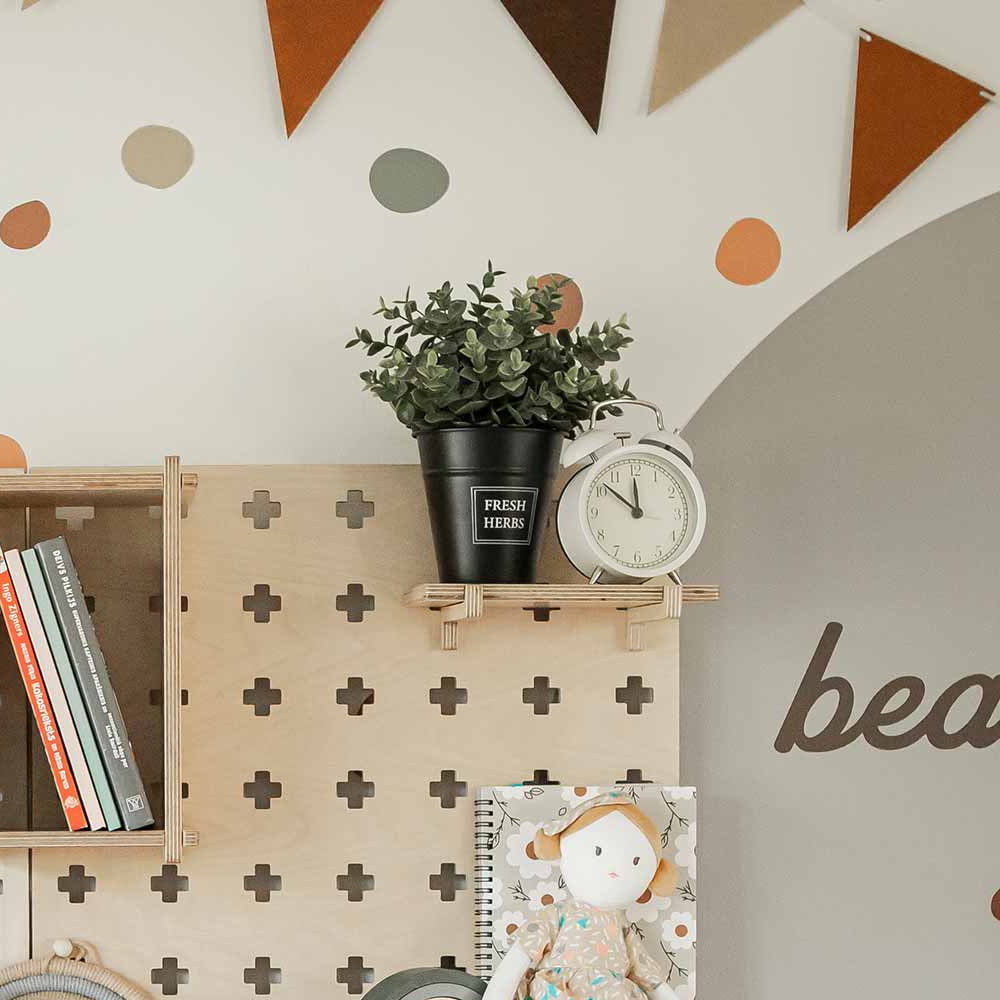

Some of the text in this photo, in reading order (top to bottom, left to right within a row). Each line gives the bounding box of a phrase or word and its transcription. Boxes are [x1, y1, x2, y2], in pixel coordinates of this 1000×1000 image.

[630, 464, 641, 476] 12
[611, 471, 619, 483] 11
[653, 471, 657, 482] 1
[596, 486, 607, 497] 10
[668, 486, 675, 499] 2
[484, 499, 526, 511] FRESH
[591, 507, 598, 519] 9
[673, 508, 681, 520] 3
[484, 517, 524, 529] HERBS
[597, 529, 605, 540] 8
[613, 545, 620, 557] 7
[634, 550, 641, 562] 6
[654, 545, 662, 557] 5
[52, 549, 67, 575] DEIVS
[0, 582, 25, 637] Ingo Zigners
